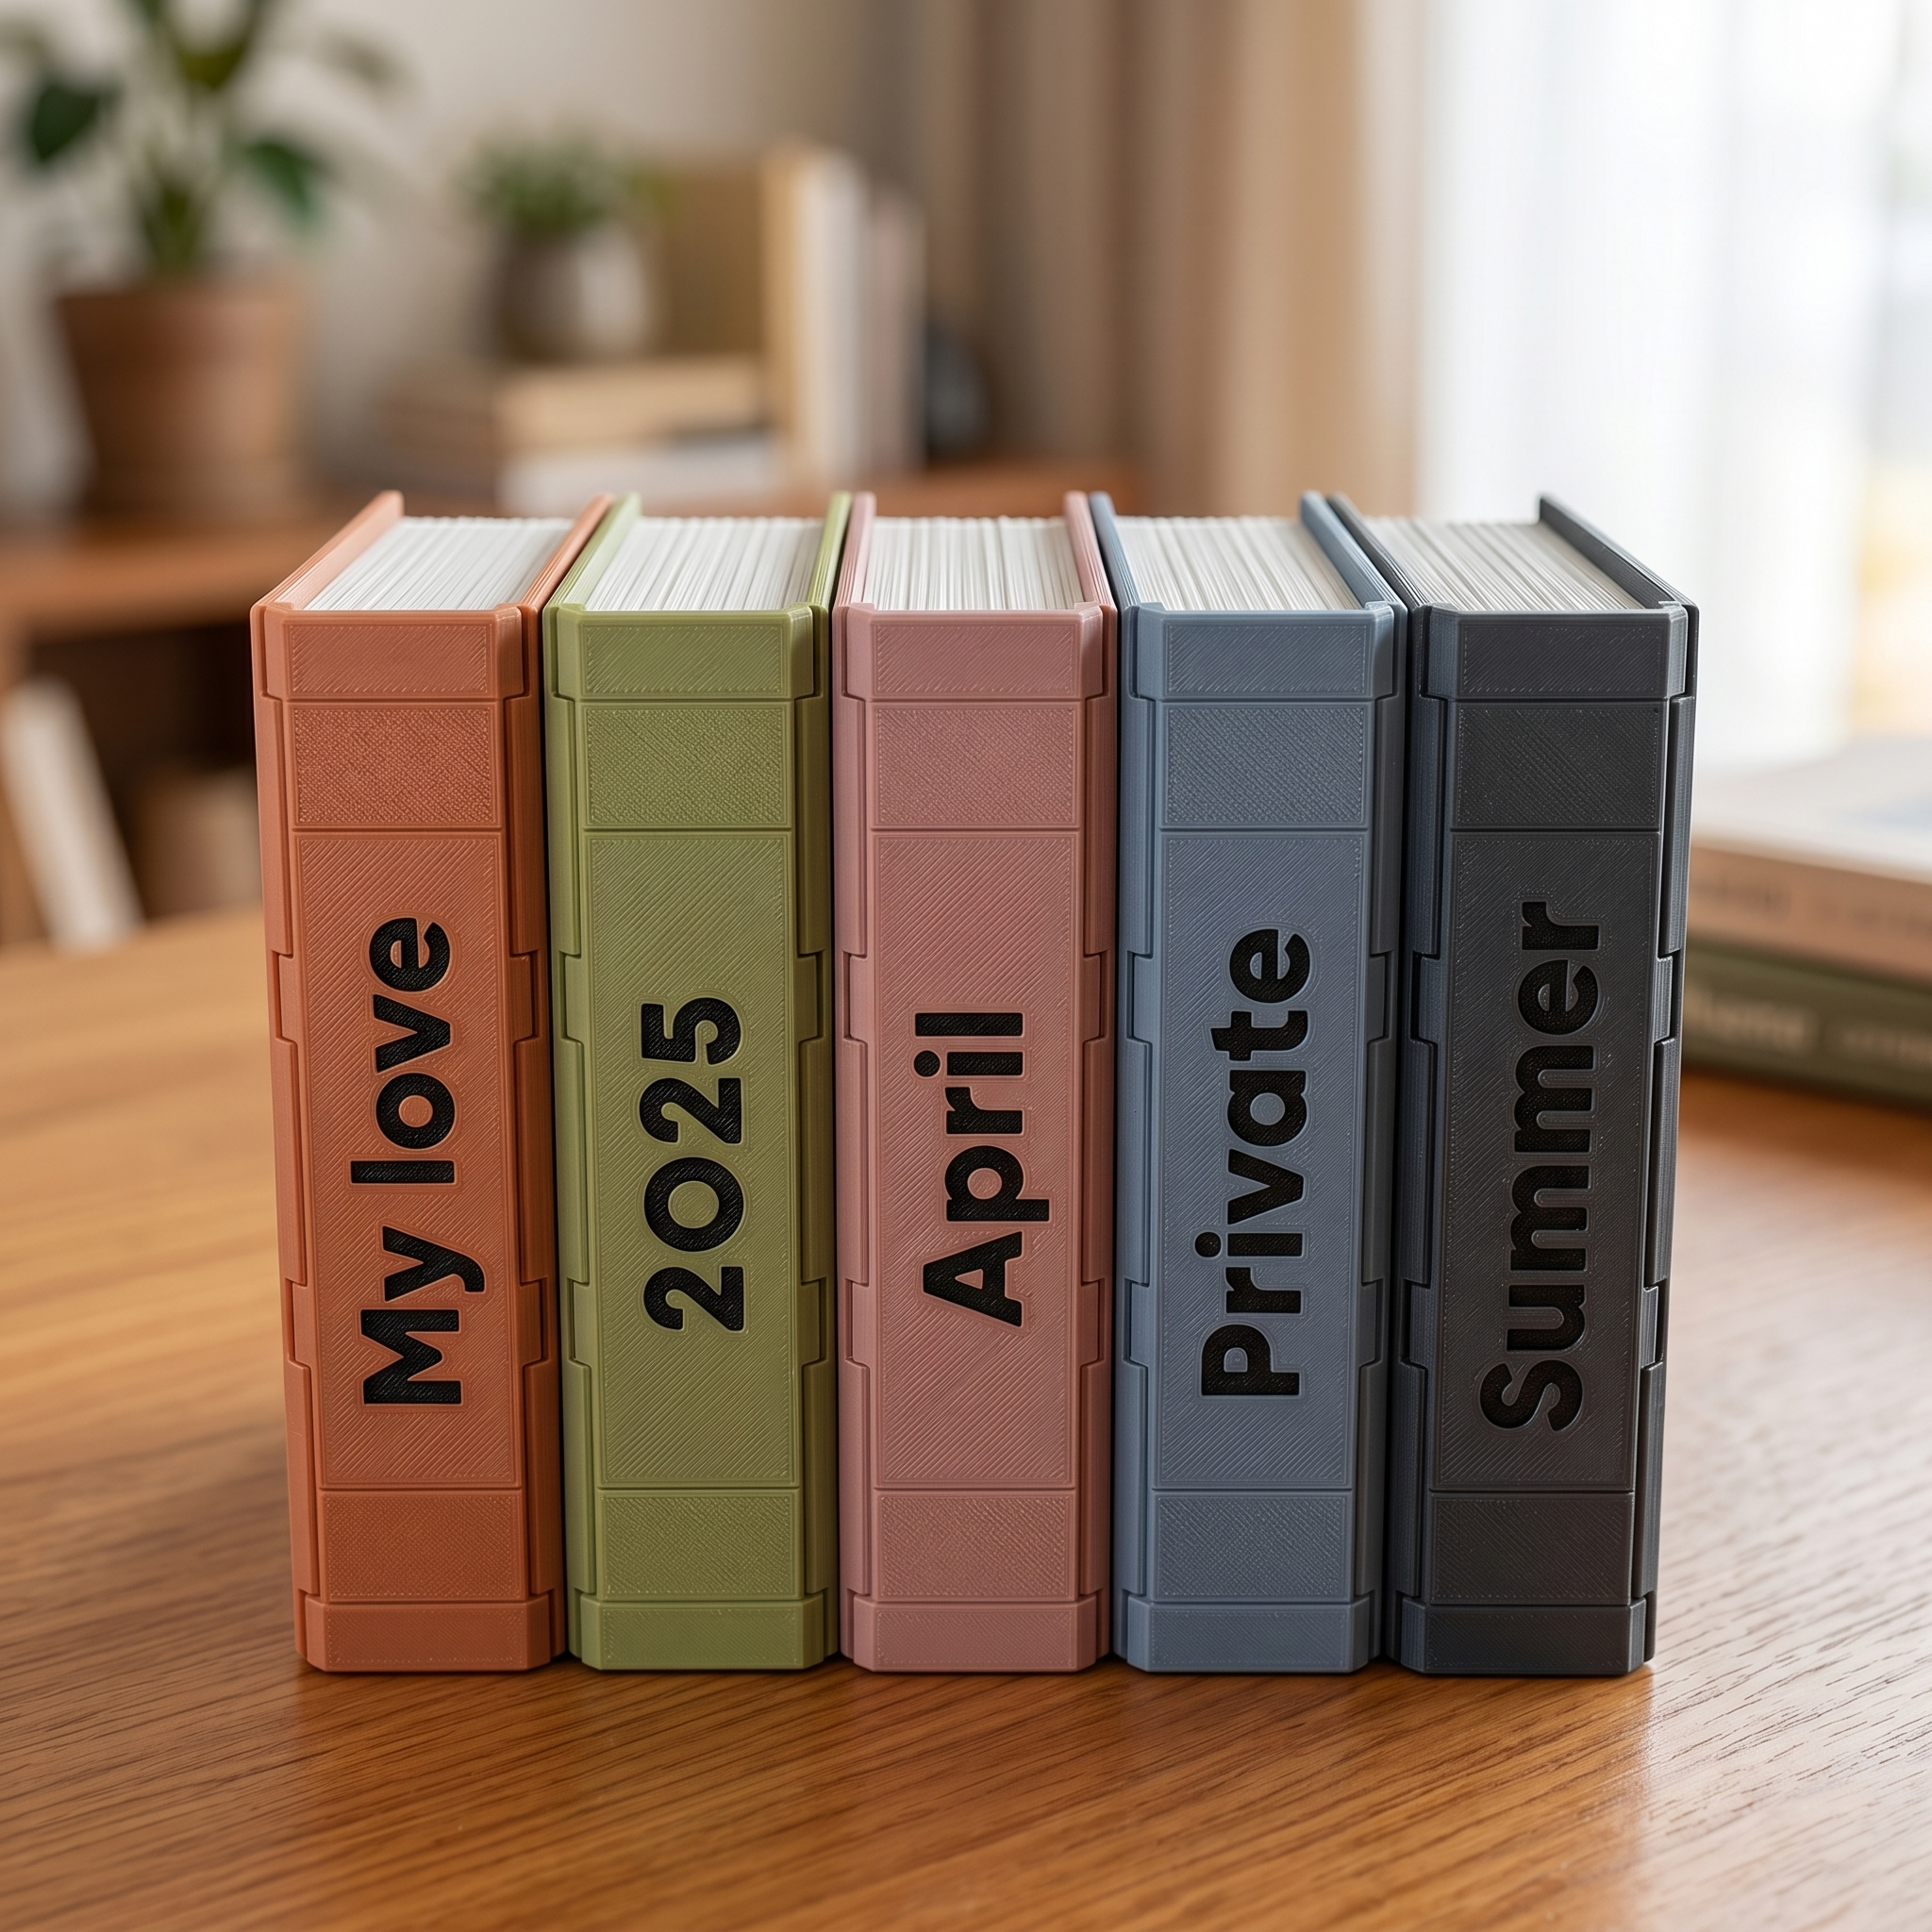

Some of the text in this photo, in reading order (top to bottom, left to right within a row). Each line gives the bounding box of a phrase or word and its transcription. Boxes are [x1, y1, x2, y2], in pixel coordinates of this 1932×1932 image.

[351, 915, 485, 1405] My love
[640, 997, 744, 1332] 2025
[913, 1011, 1050, 1327] April
[1194, 926, 1310, 1398] Private
[1479, 900, 1601, 1432] Summer
